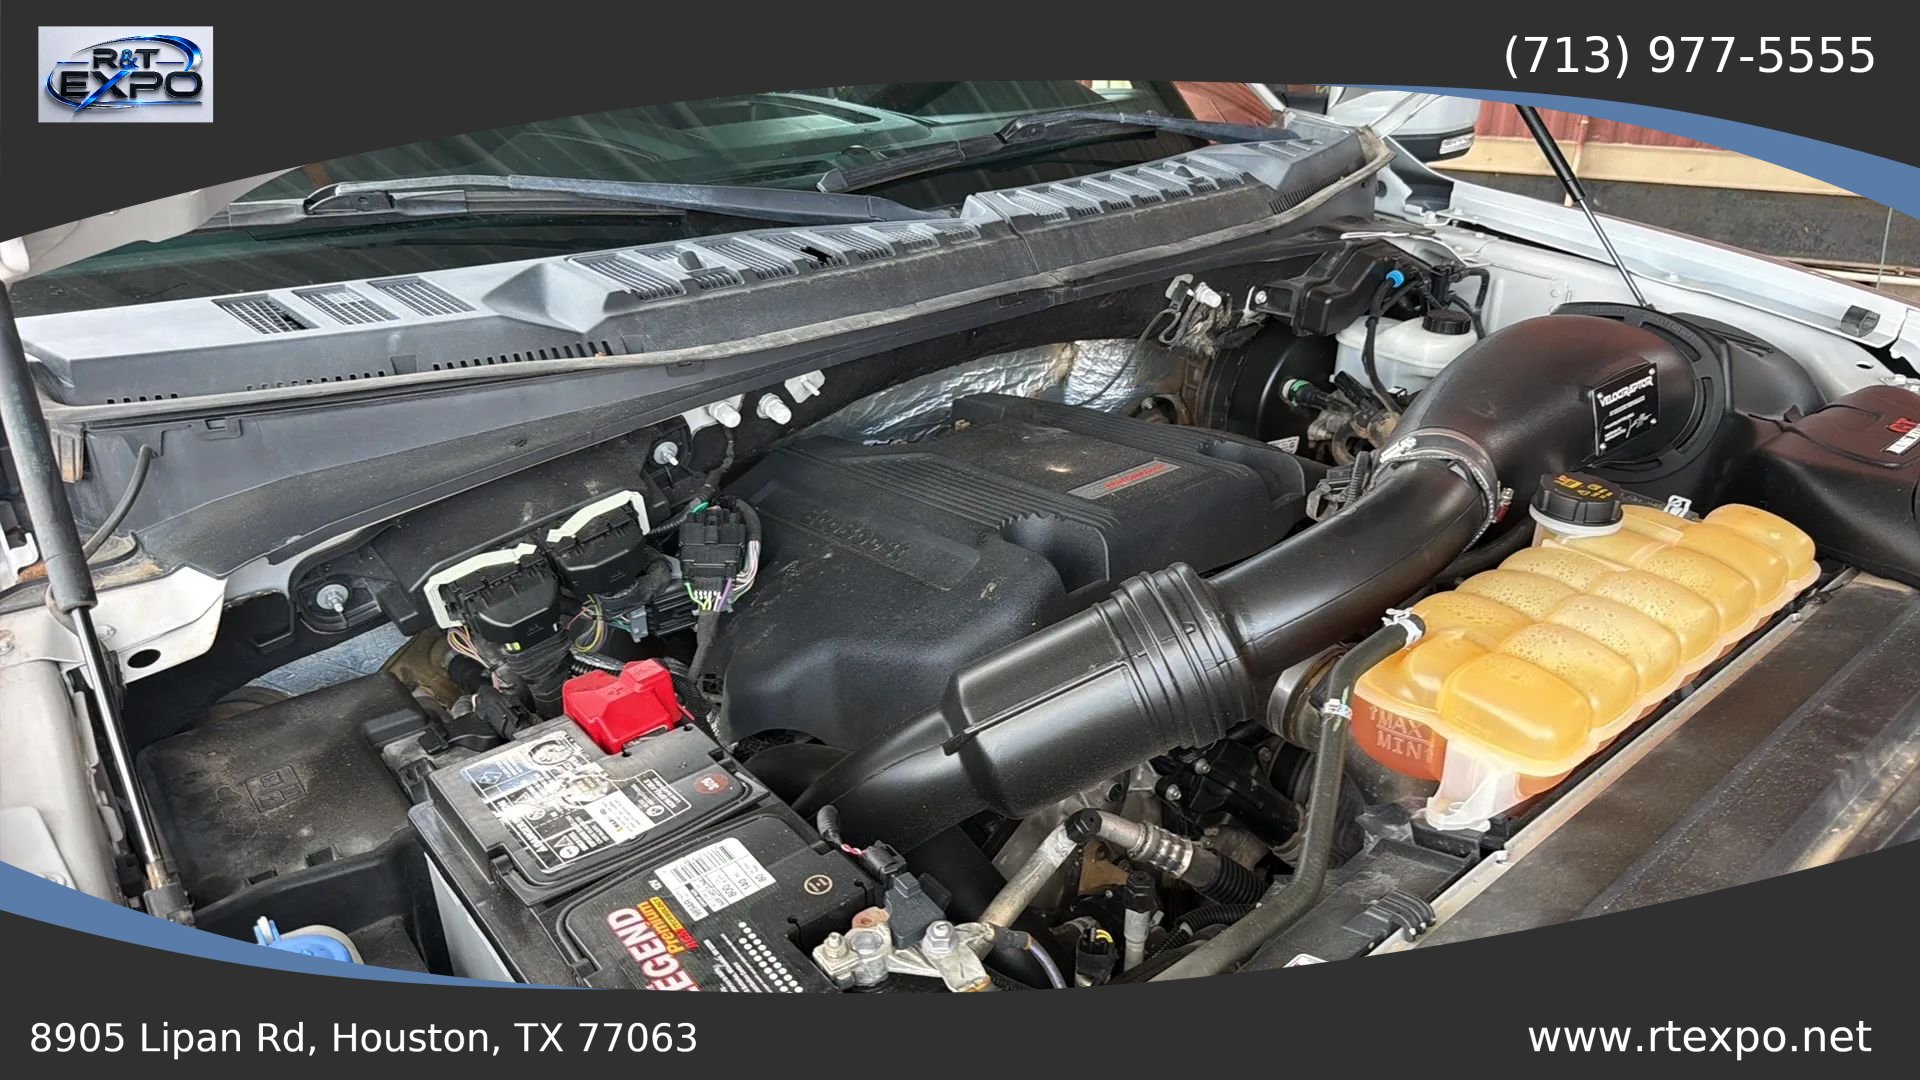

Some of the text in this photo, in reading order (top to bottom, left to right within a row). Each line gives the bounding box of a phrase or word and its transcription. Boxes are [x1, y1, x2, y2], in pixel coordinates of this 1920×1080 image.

[1378, 710, 1424, 738] MAX
[1376, 730, 1423, 760] MIN
[636, 900, 686, 956] Premium
